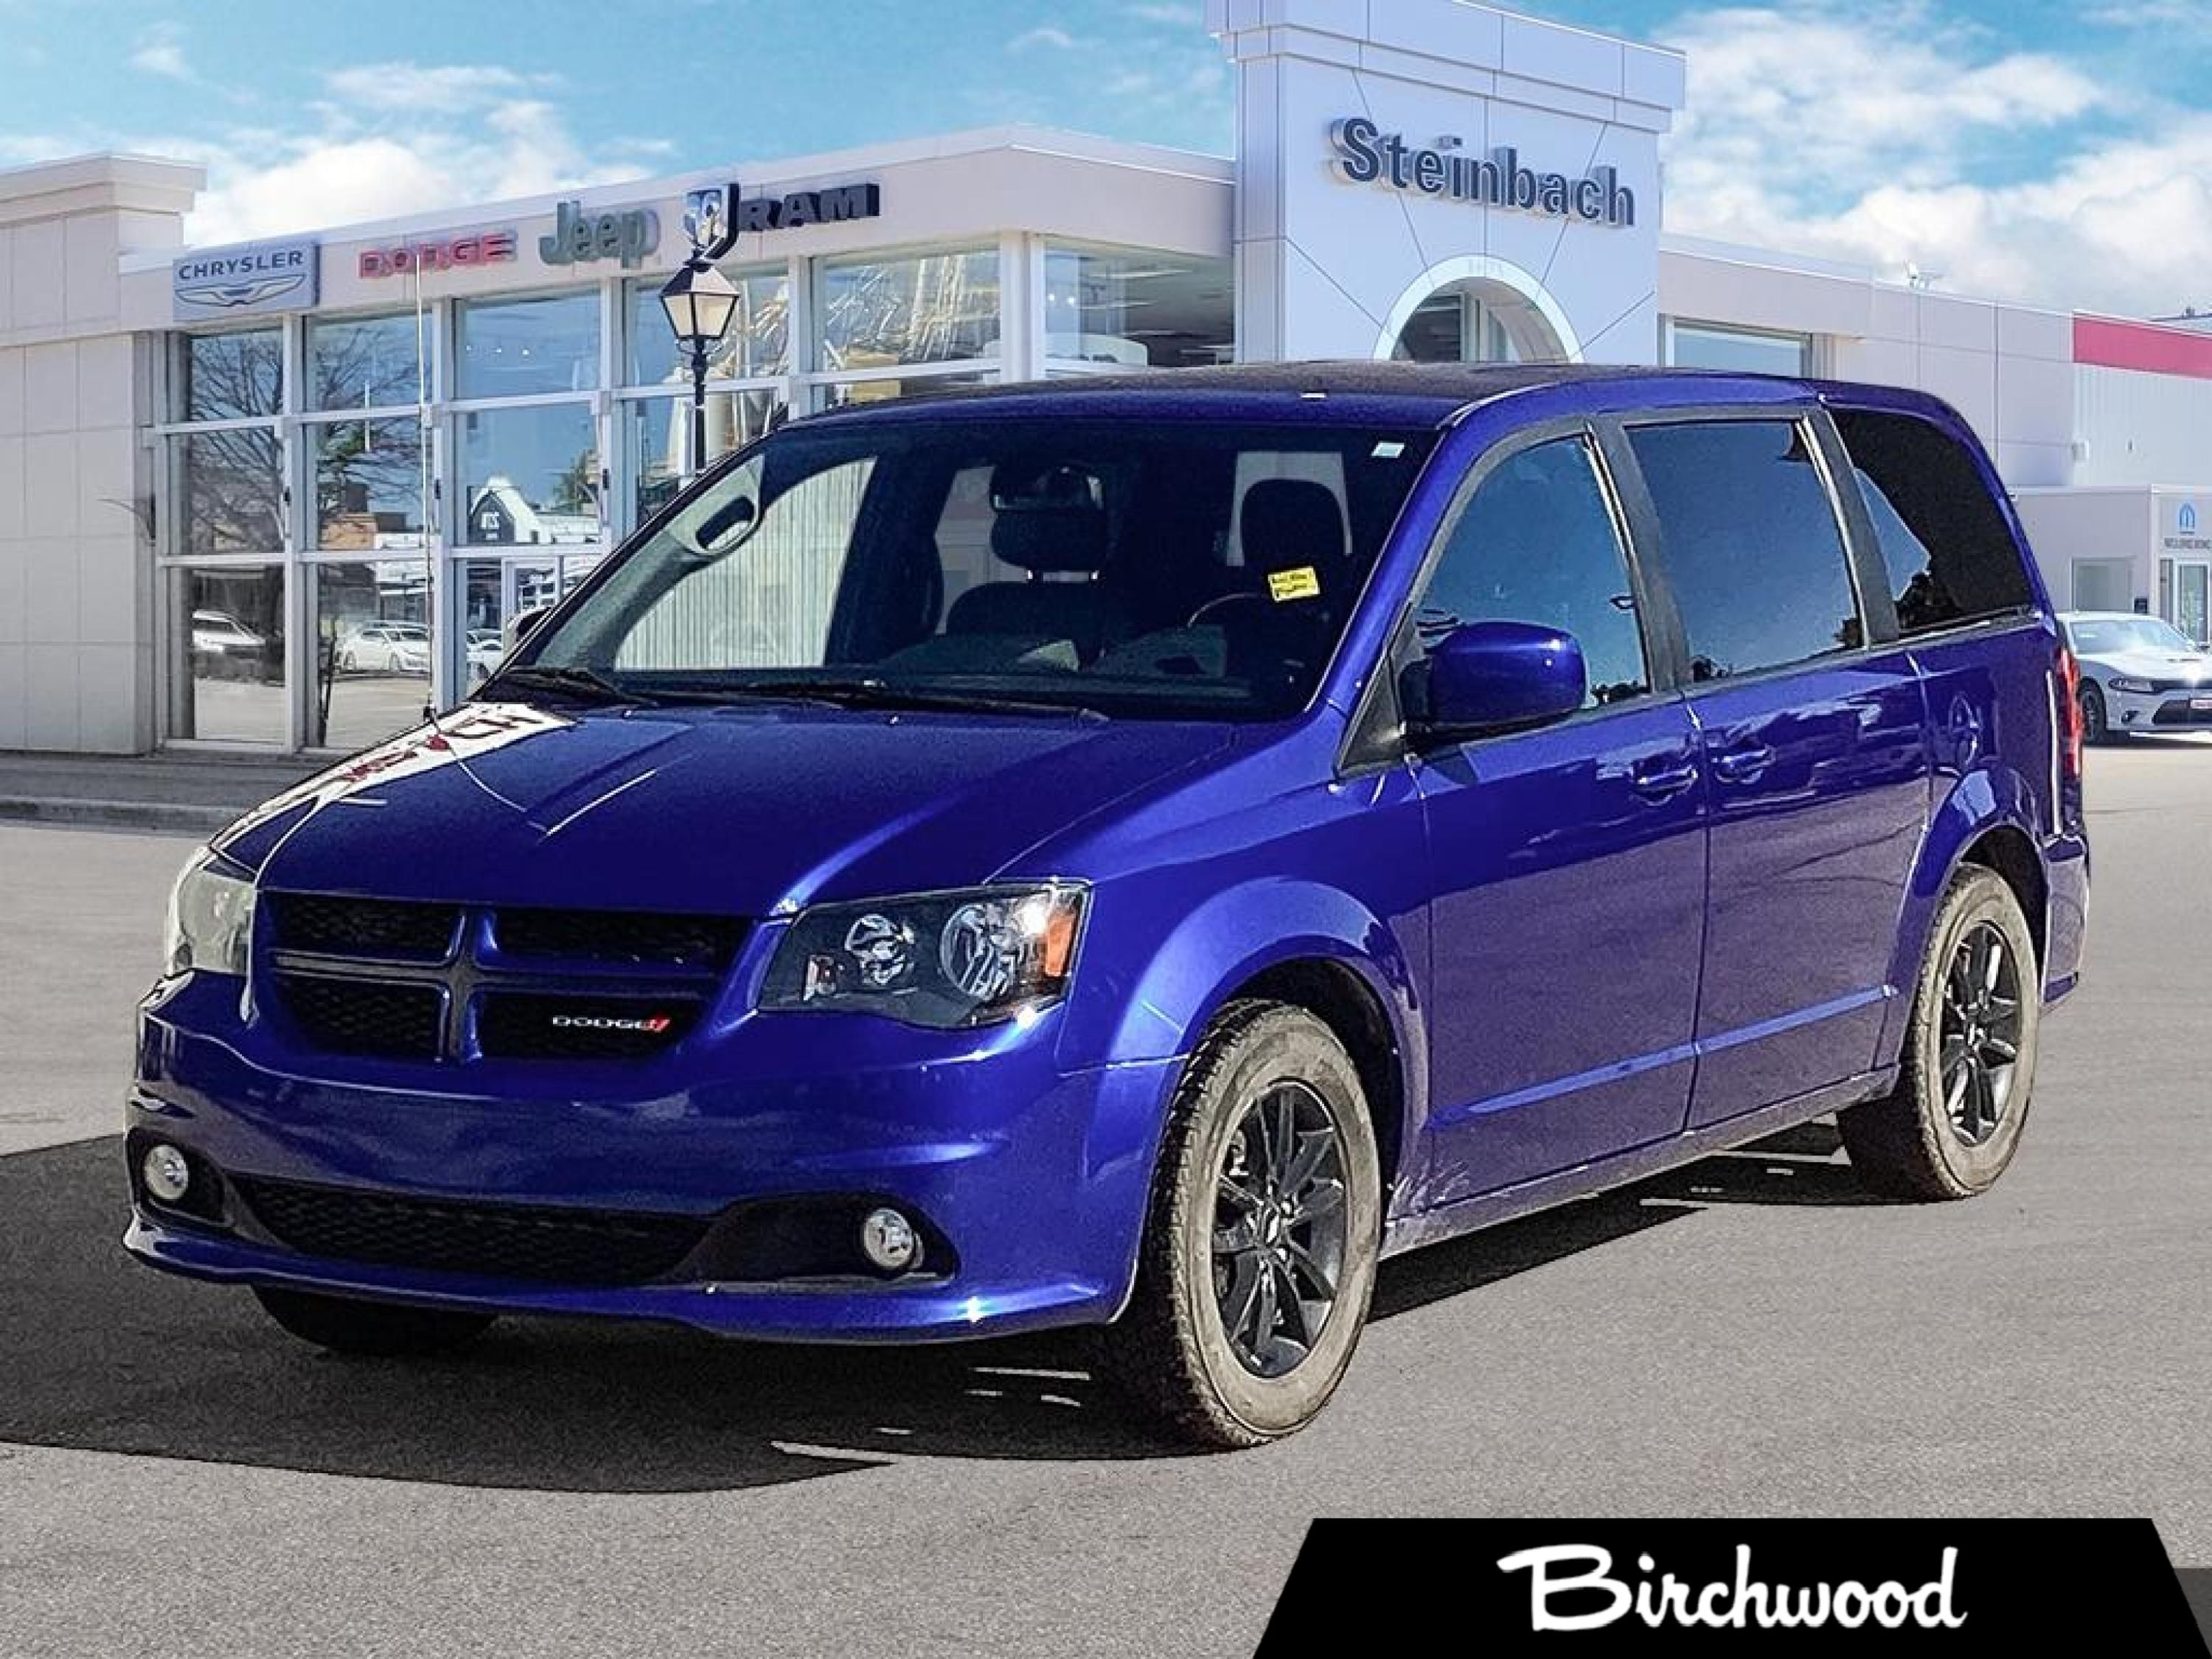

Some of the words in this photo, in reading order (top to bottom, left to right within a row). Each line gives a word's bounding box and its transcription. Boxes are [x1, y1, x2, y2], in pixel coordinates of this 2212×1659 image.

[1331, 118, 1634, 227] Steinbach
[740, 184, 879, 231] RAM
[358, 233, 516, 278] DODGE
[539, 200, 660, 268] Jeep
[178, 250, 304, 280] CHRYSLER
[551, 1015, 652, 1031] DODGE
